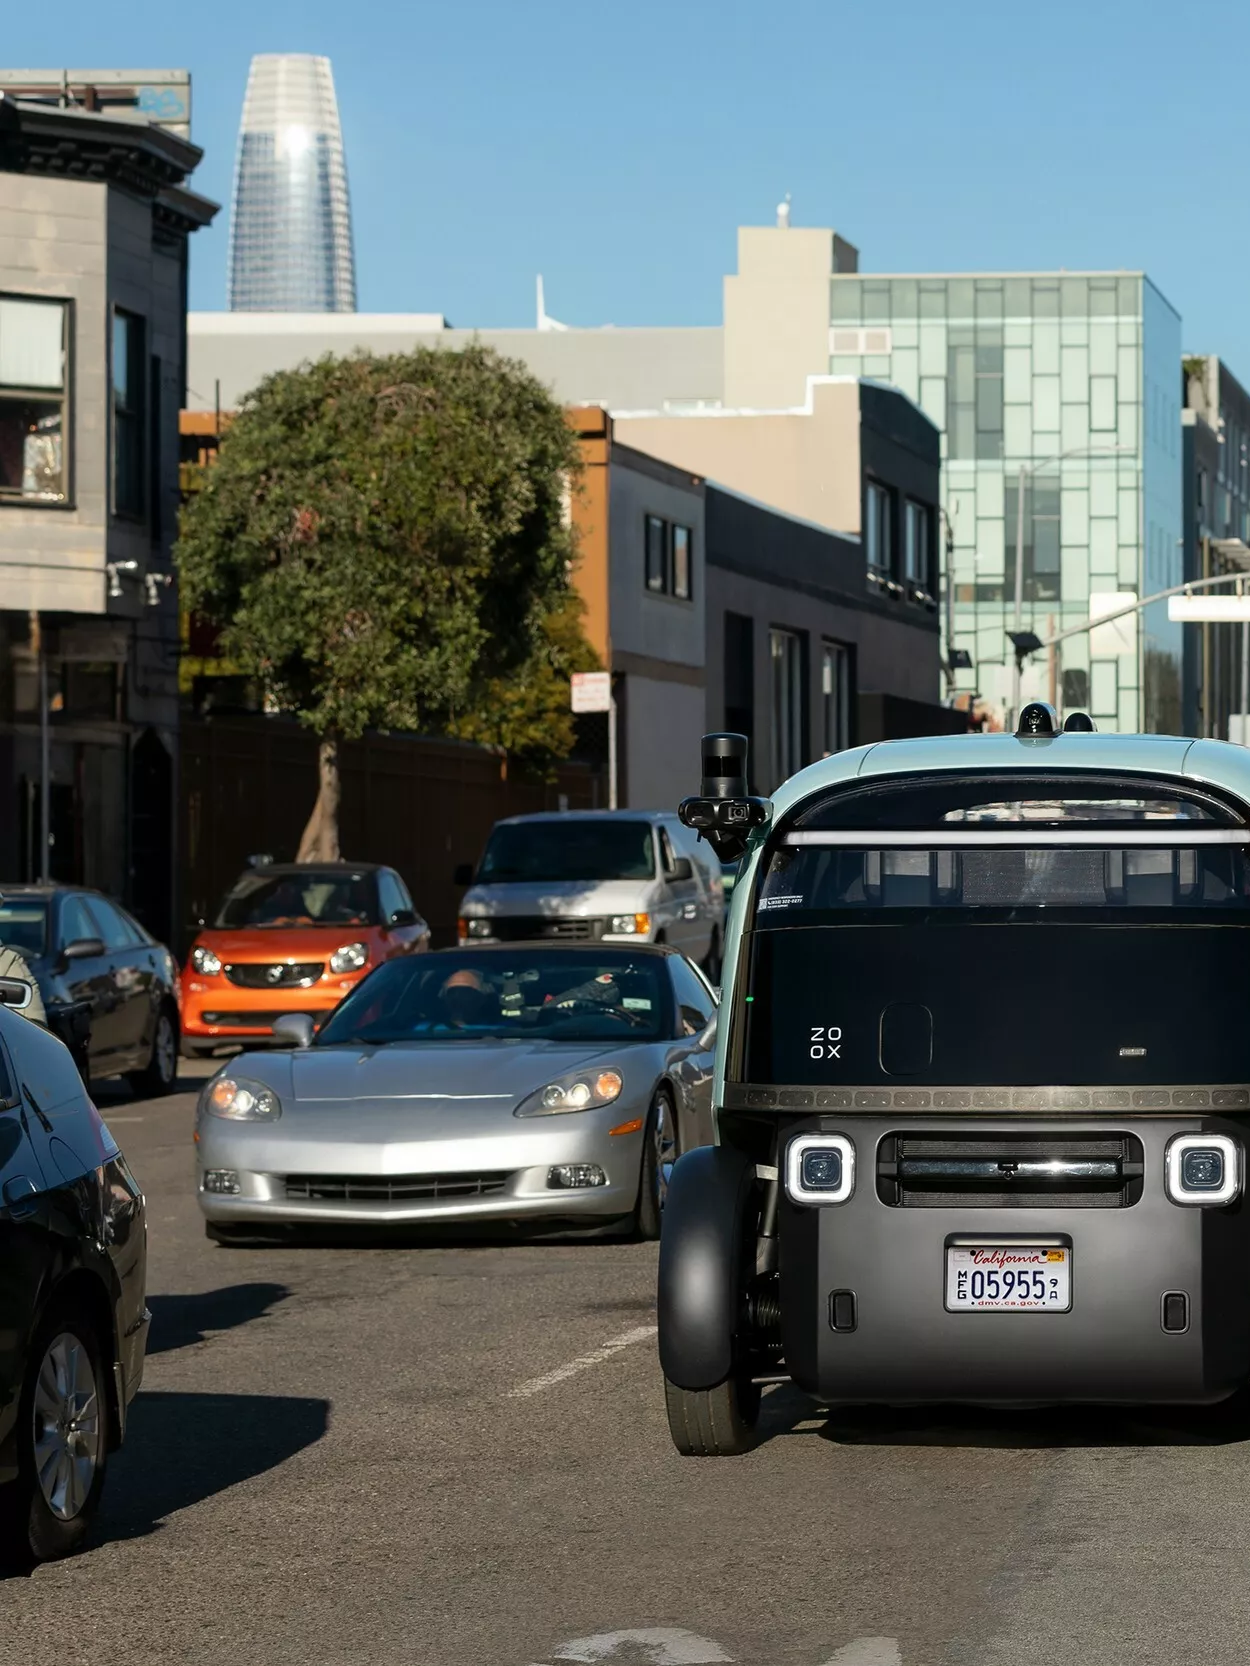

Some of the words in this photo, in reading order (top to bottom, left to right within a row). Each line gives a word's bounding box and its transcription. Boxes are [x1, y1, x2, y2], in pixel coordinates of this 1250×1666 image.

[811, 1027, 842, 1041] ZO
[810, 1045, 841, 1059] OX
[974, 1249, 1048, 1268] California
[957, 1270, 967, 1299] MFG
[971, 1270, 1045, 1299] 05955
